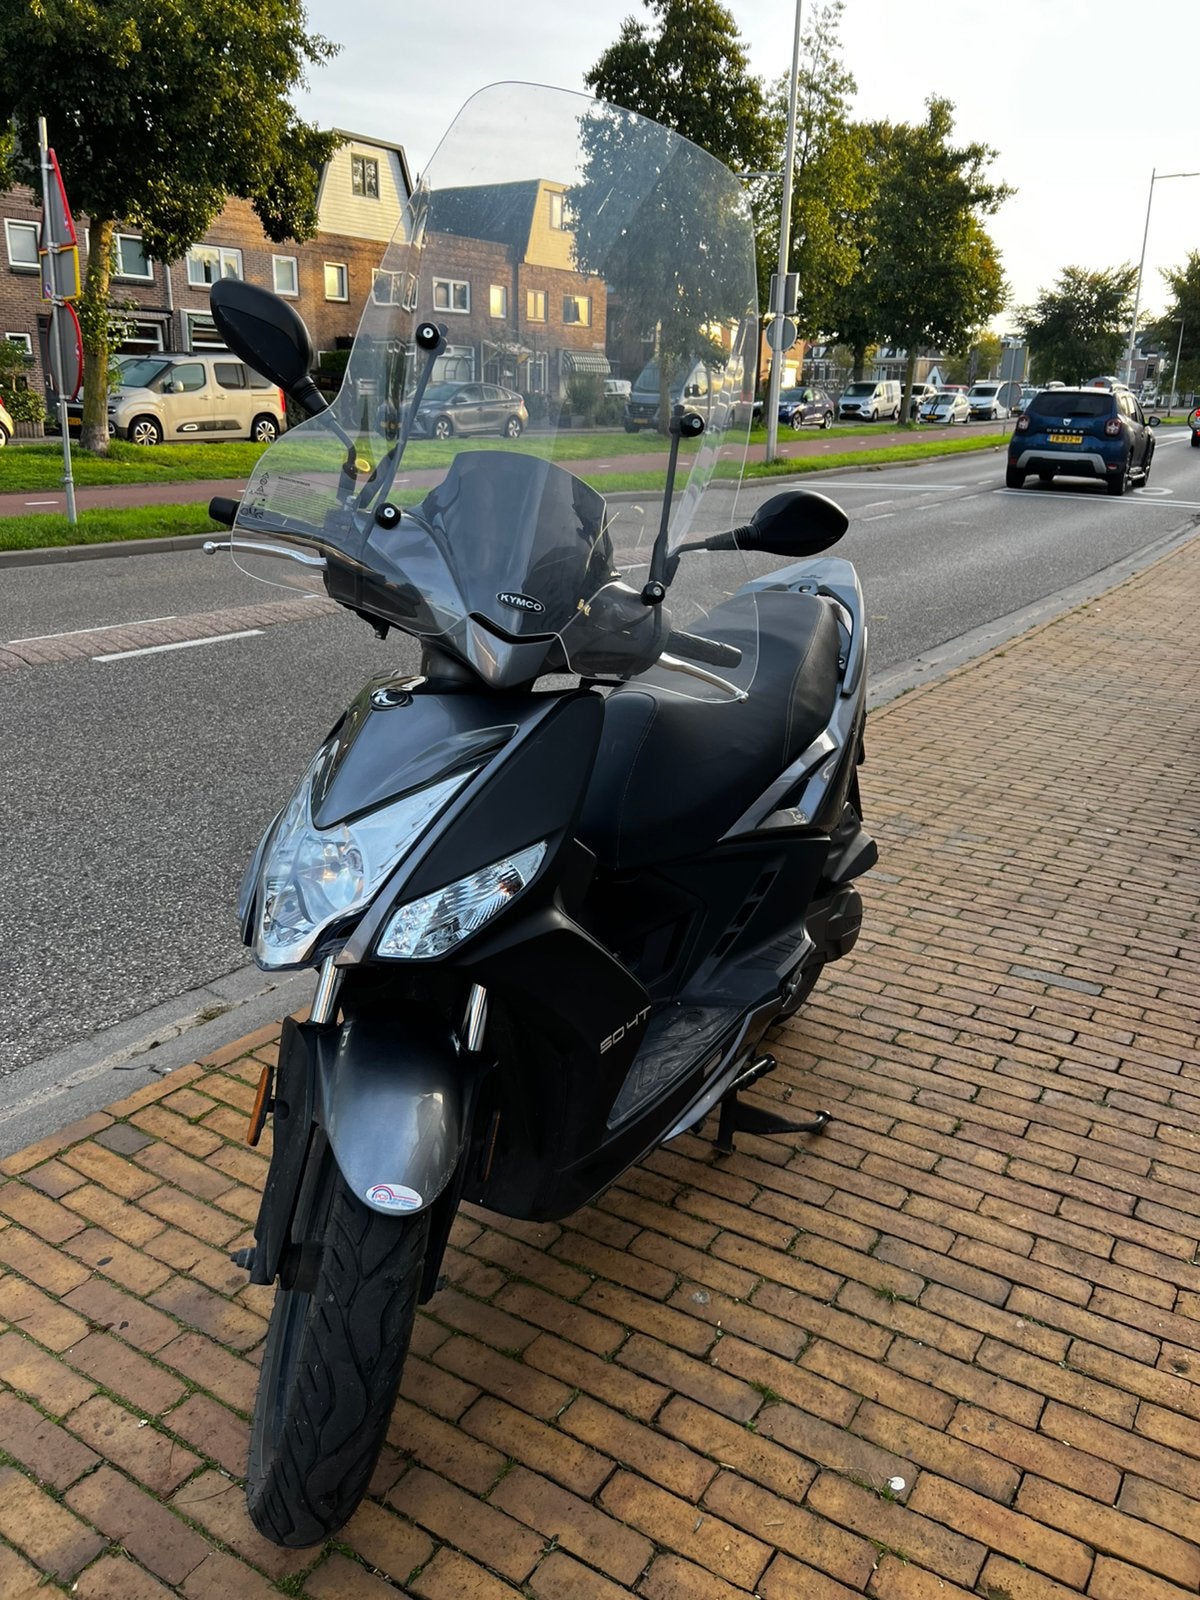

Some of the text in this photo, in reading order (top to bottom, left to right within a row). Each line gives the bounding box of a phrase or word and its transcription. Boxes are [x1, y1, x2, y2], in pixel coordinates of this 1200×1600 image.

[500, 593, 543, 611] KYMCO
[600, 1005, 652, 1055] 50 4T
